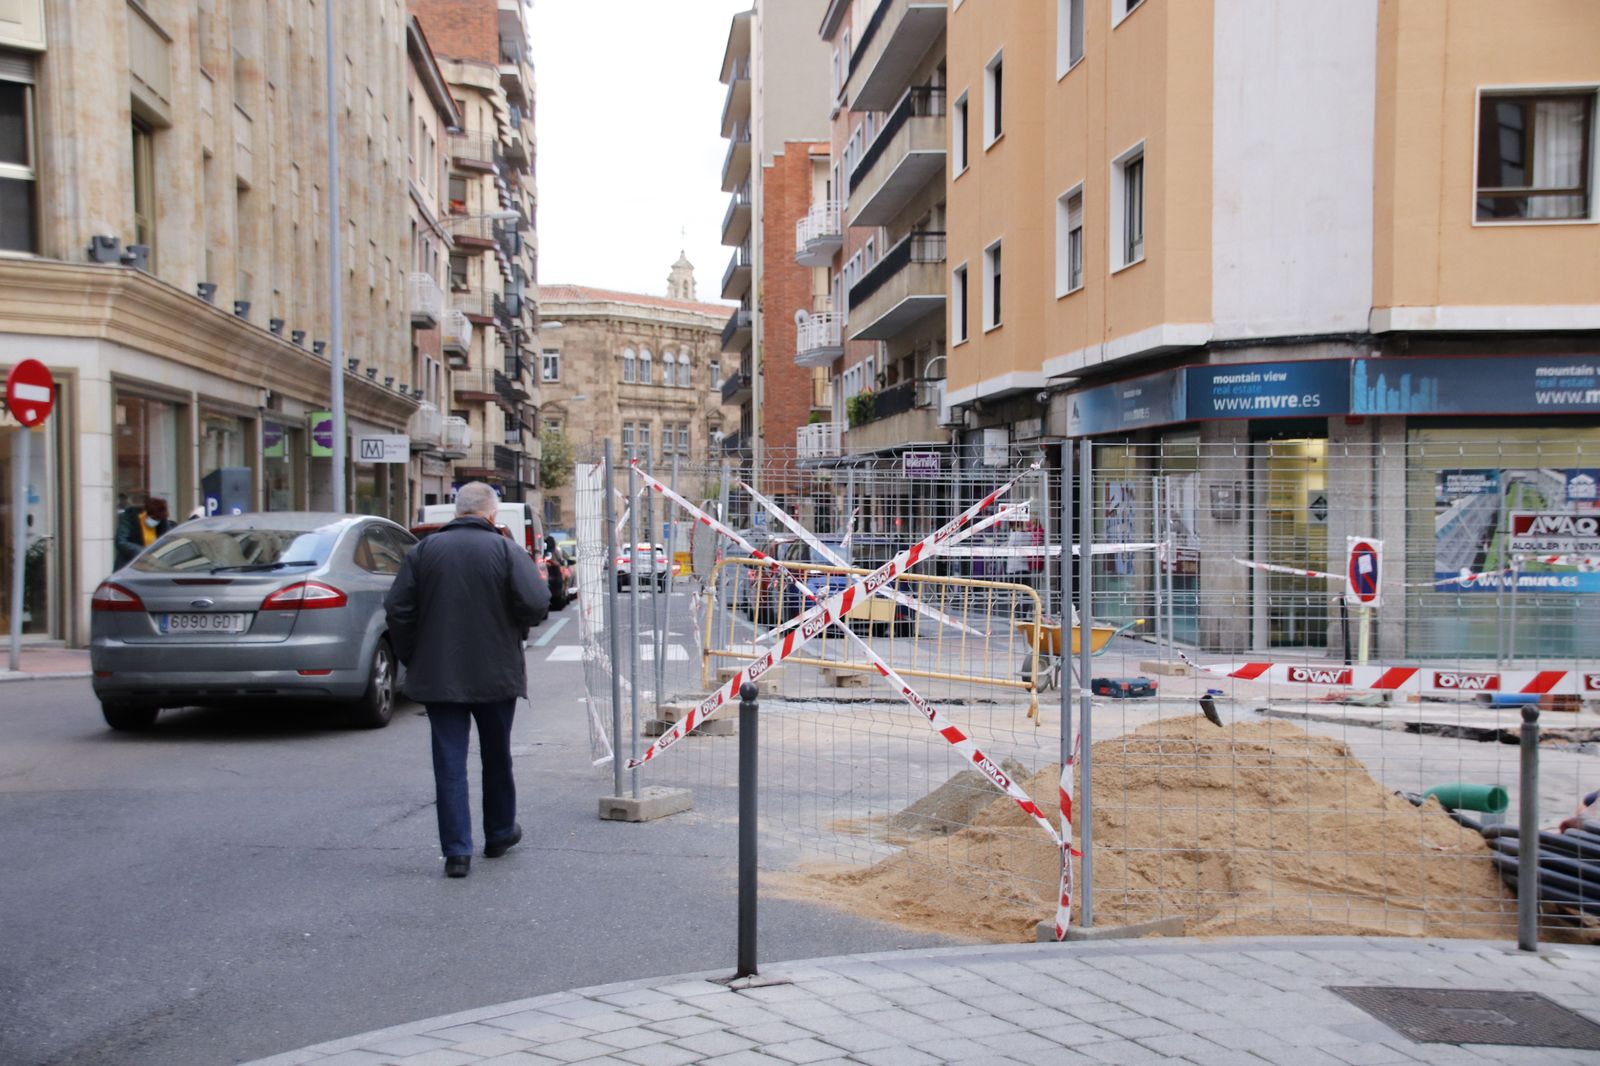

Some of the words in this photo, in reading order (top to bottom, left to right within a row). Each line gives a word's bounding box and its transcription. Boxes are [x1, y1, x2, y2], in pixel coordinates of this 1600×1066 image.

[1213, 373, 1260, 384] mountain
[1263, 371, 1287, 382] view
[1535, 365, 1594, 376] mountain
[1213, 385, 1230, 394] real
[1233, 384, 1262, 394] estate
[1213, 394, 1320, 410] www.mvre.es
[1517, 515, 1598, 536] AMAQ
[1512, 542, 1559, 550] ALQUILER
[1562, 542, 1569, 550] Y
[1293, 668, 1349, 683] AMAQ
[1439, 674, 1497, 689] AMAQ
